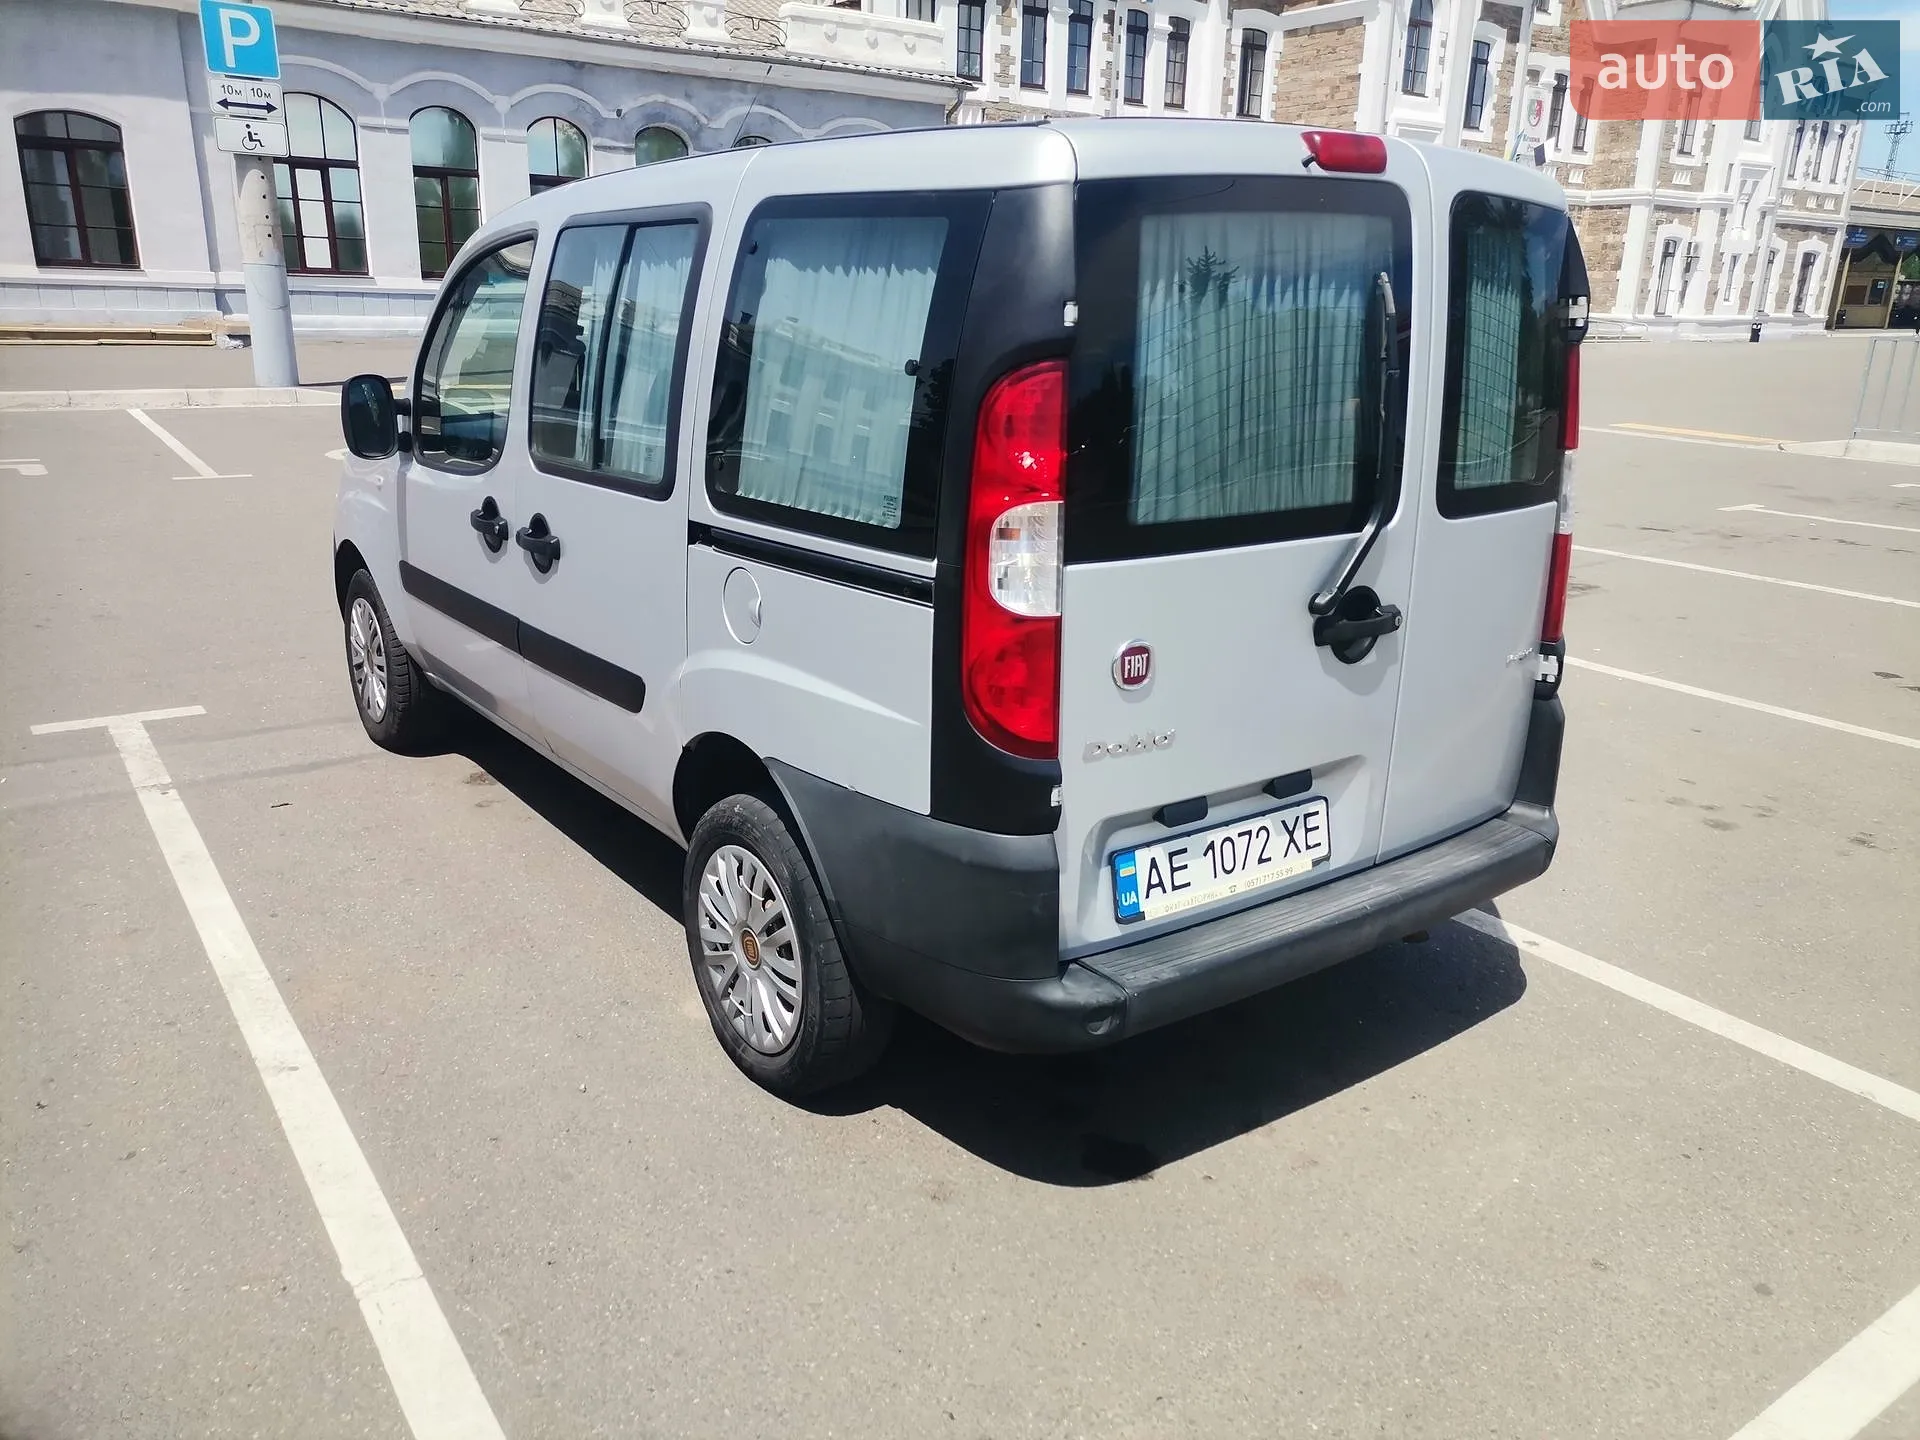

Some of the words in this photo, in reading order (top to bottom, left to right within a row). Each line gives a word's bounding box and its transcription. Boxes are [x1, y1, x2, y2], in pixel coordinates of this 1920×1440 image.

[220, 8, 260, 68] P
[1124, 653, 1148, 679] FIAT
[1145, 847, 1191, 899] AE
[1203, 825, 1271, 879] 1072
[1281, 810, 1321, 858] XE
[1121, 892, 1138, 906] UA
